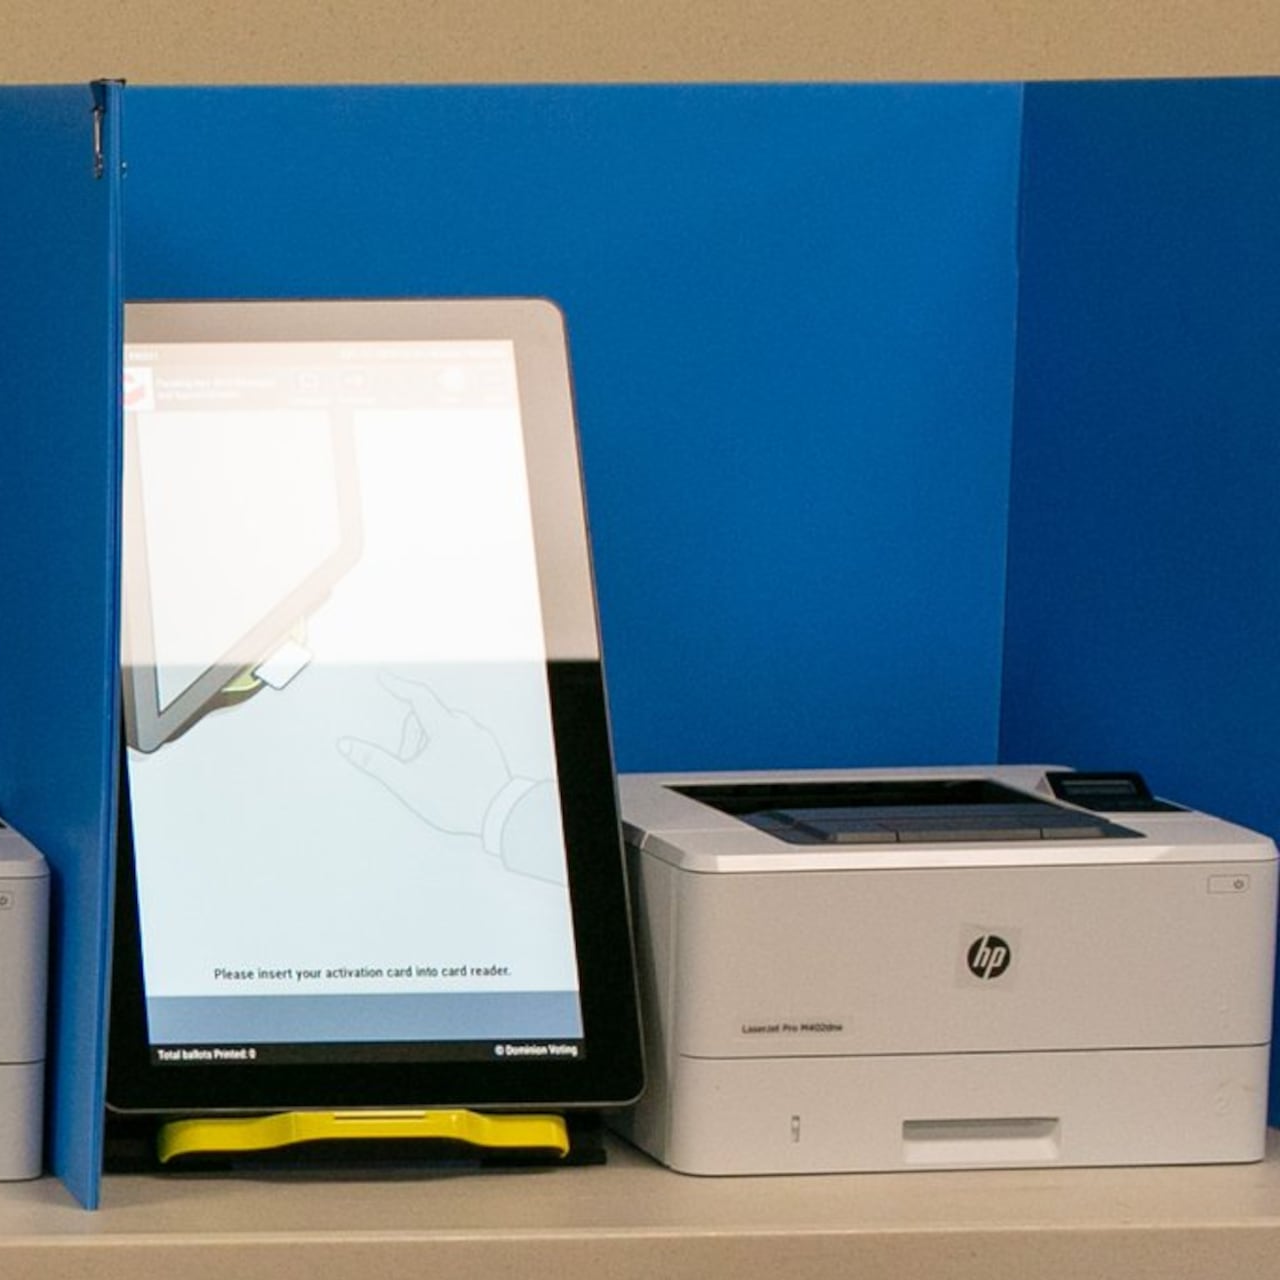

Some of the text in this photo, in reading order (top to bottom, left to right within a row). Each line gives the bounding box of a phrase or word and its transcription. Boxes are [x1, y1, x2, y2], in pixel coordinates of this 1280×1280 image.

[967, 935, 1011, 979] hp
[214, 964, 512, 982] Please insert your activation card into card reader.
[741, 1024, 780, 1034] LaserJet
[782, 1023, 798, 1033] Pro
[157, 1048, 180, 1060] Total
[505, 1044, 548, 1056] Dominion
[547, 1043, 578, 1058] Voting
